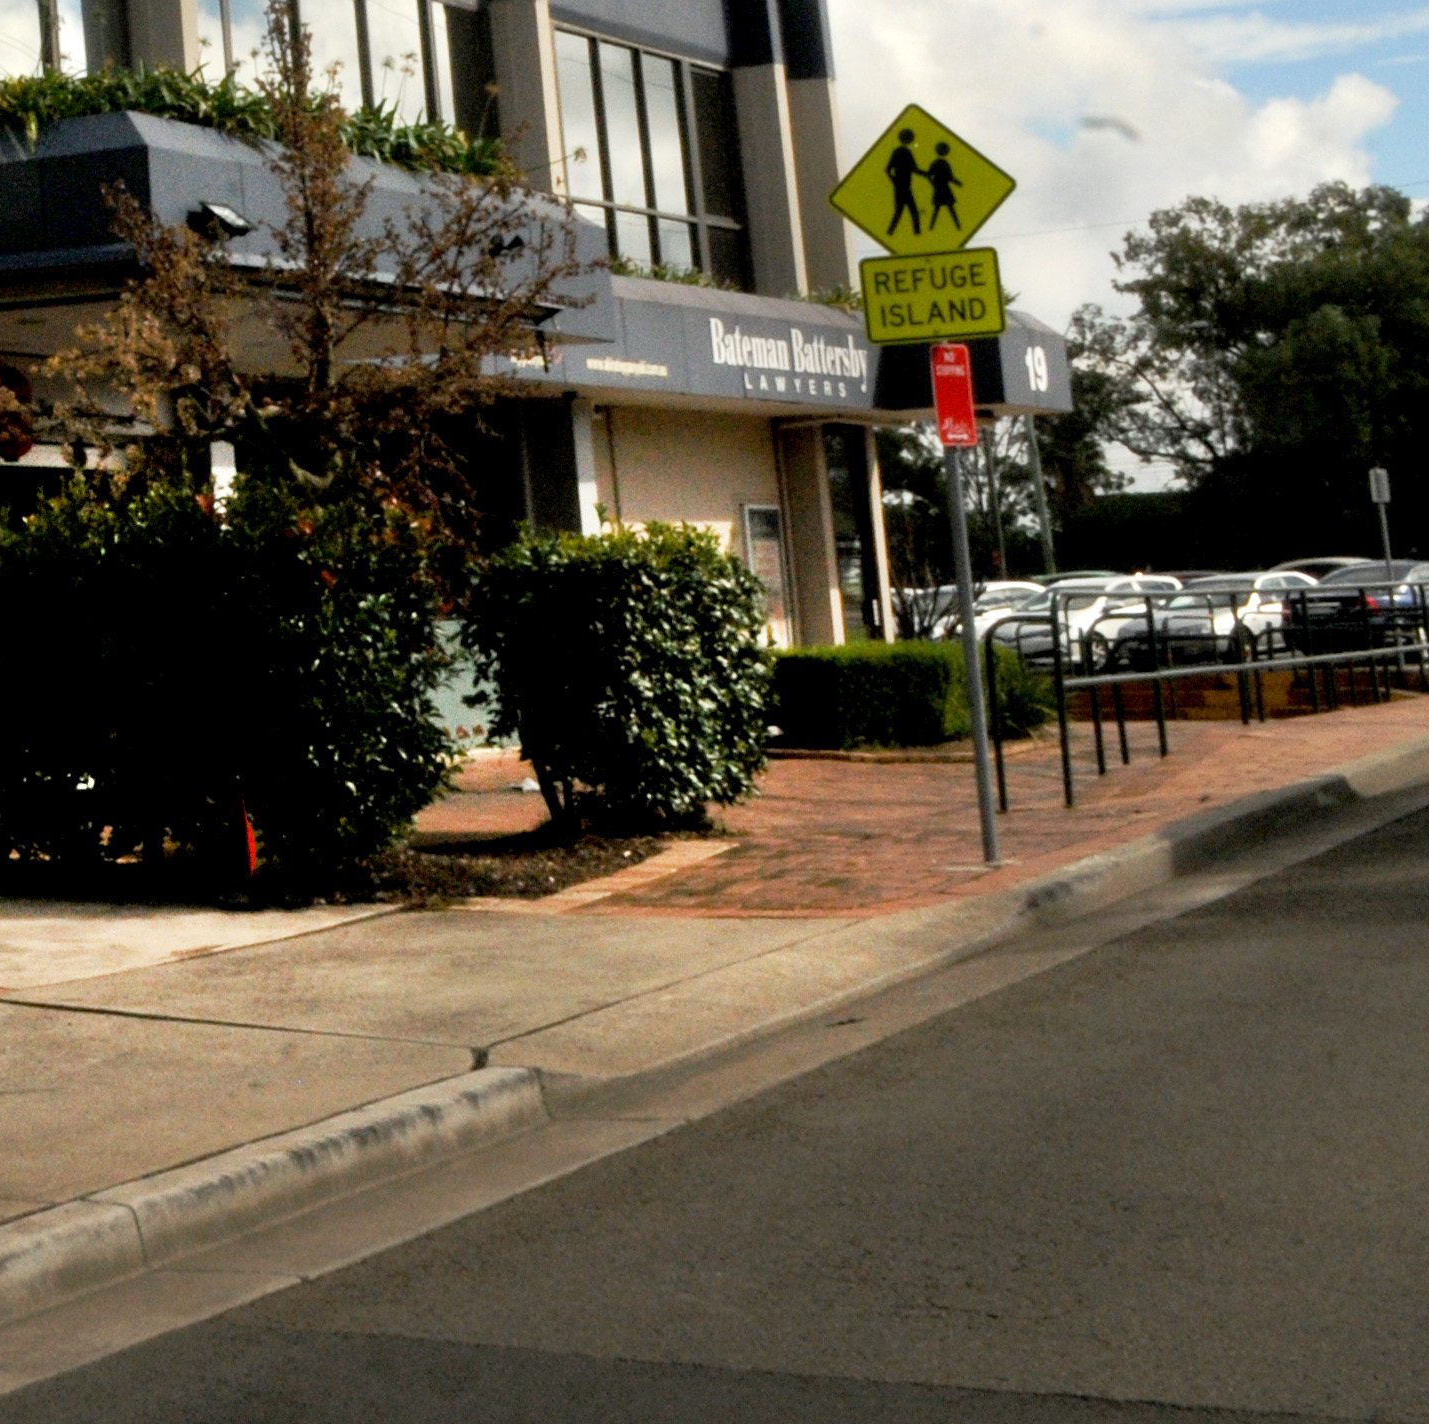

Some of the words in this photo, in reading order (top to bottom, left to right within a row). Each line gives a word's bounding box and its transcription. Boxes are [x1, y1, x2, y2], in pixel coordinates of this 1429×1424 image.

[874, 263, 986, 295] REFUGE
[881, 297, 986, 327] ISLAND
[709, 317, 790, 371] Bateman
[791, 328, 869, 393] Battersby
[1024, 345, 1048, 392] 19
[744, 372, 847, 398] LAWYERS
